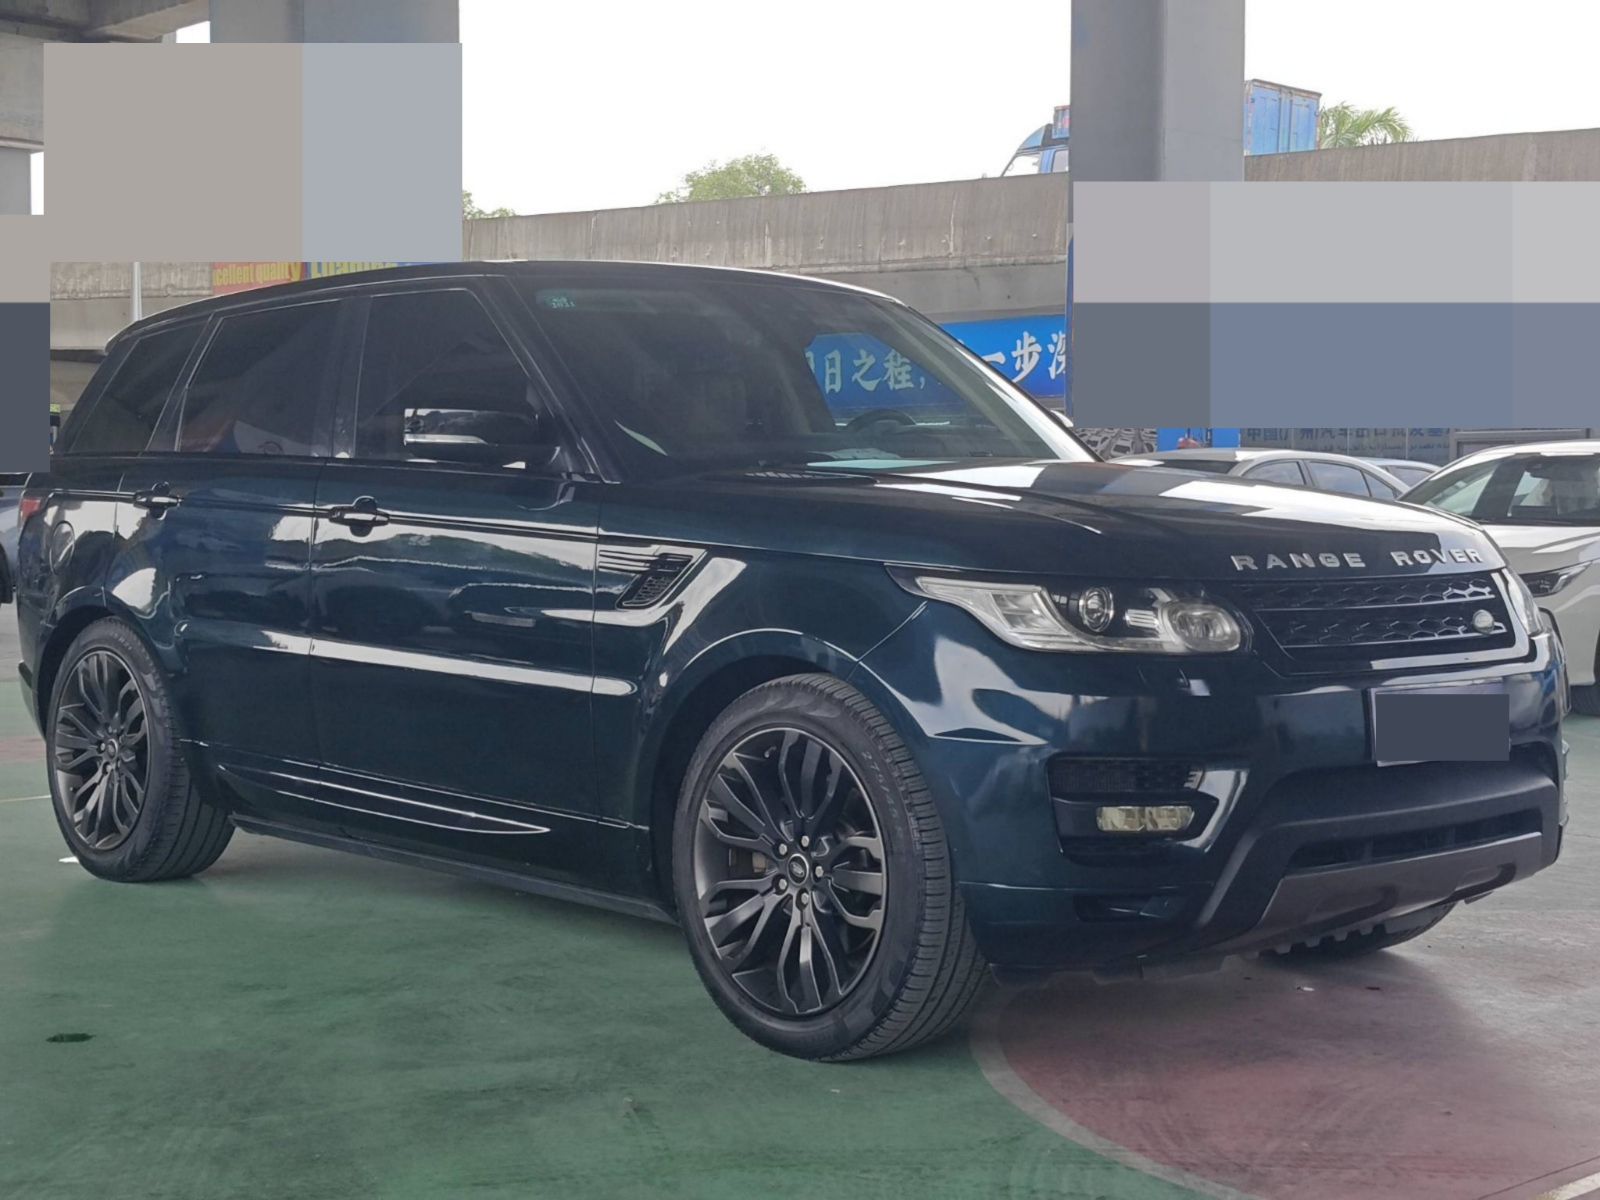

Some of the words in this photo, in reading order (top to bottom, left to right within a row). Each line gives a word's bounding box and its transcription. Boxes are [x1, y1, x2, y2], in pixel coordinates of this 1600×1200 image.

[804, 348, 926, 395] 日之程,
[1230, 552, 1366, 571] RANGE
[1390, 548, 1483, 567] ROVER
